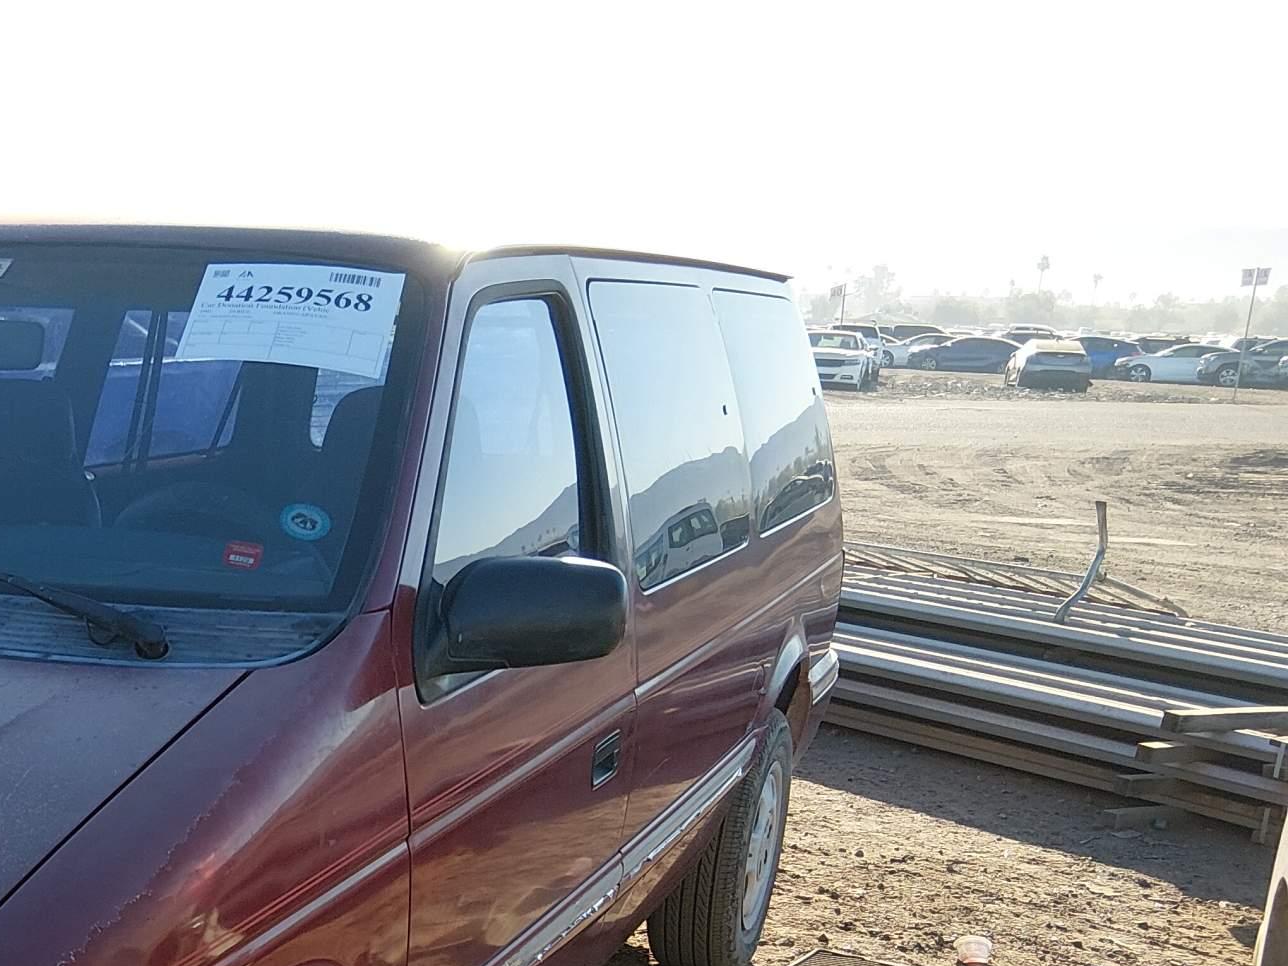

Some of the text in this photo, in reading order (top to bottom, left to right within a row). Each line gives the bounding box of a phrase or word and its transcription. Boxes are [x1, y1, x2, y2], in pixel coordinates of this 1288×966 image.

[216, 284, 373, 312] 44259568
[217, 302, 254, 310] Donation
[255, 303, 301, 312] Foundation
